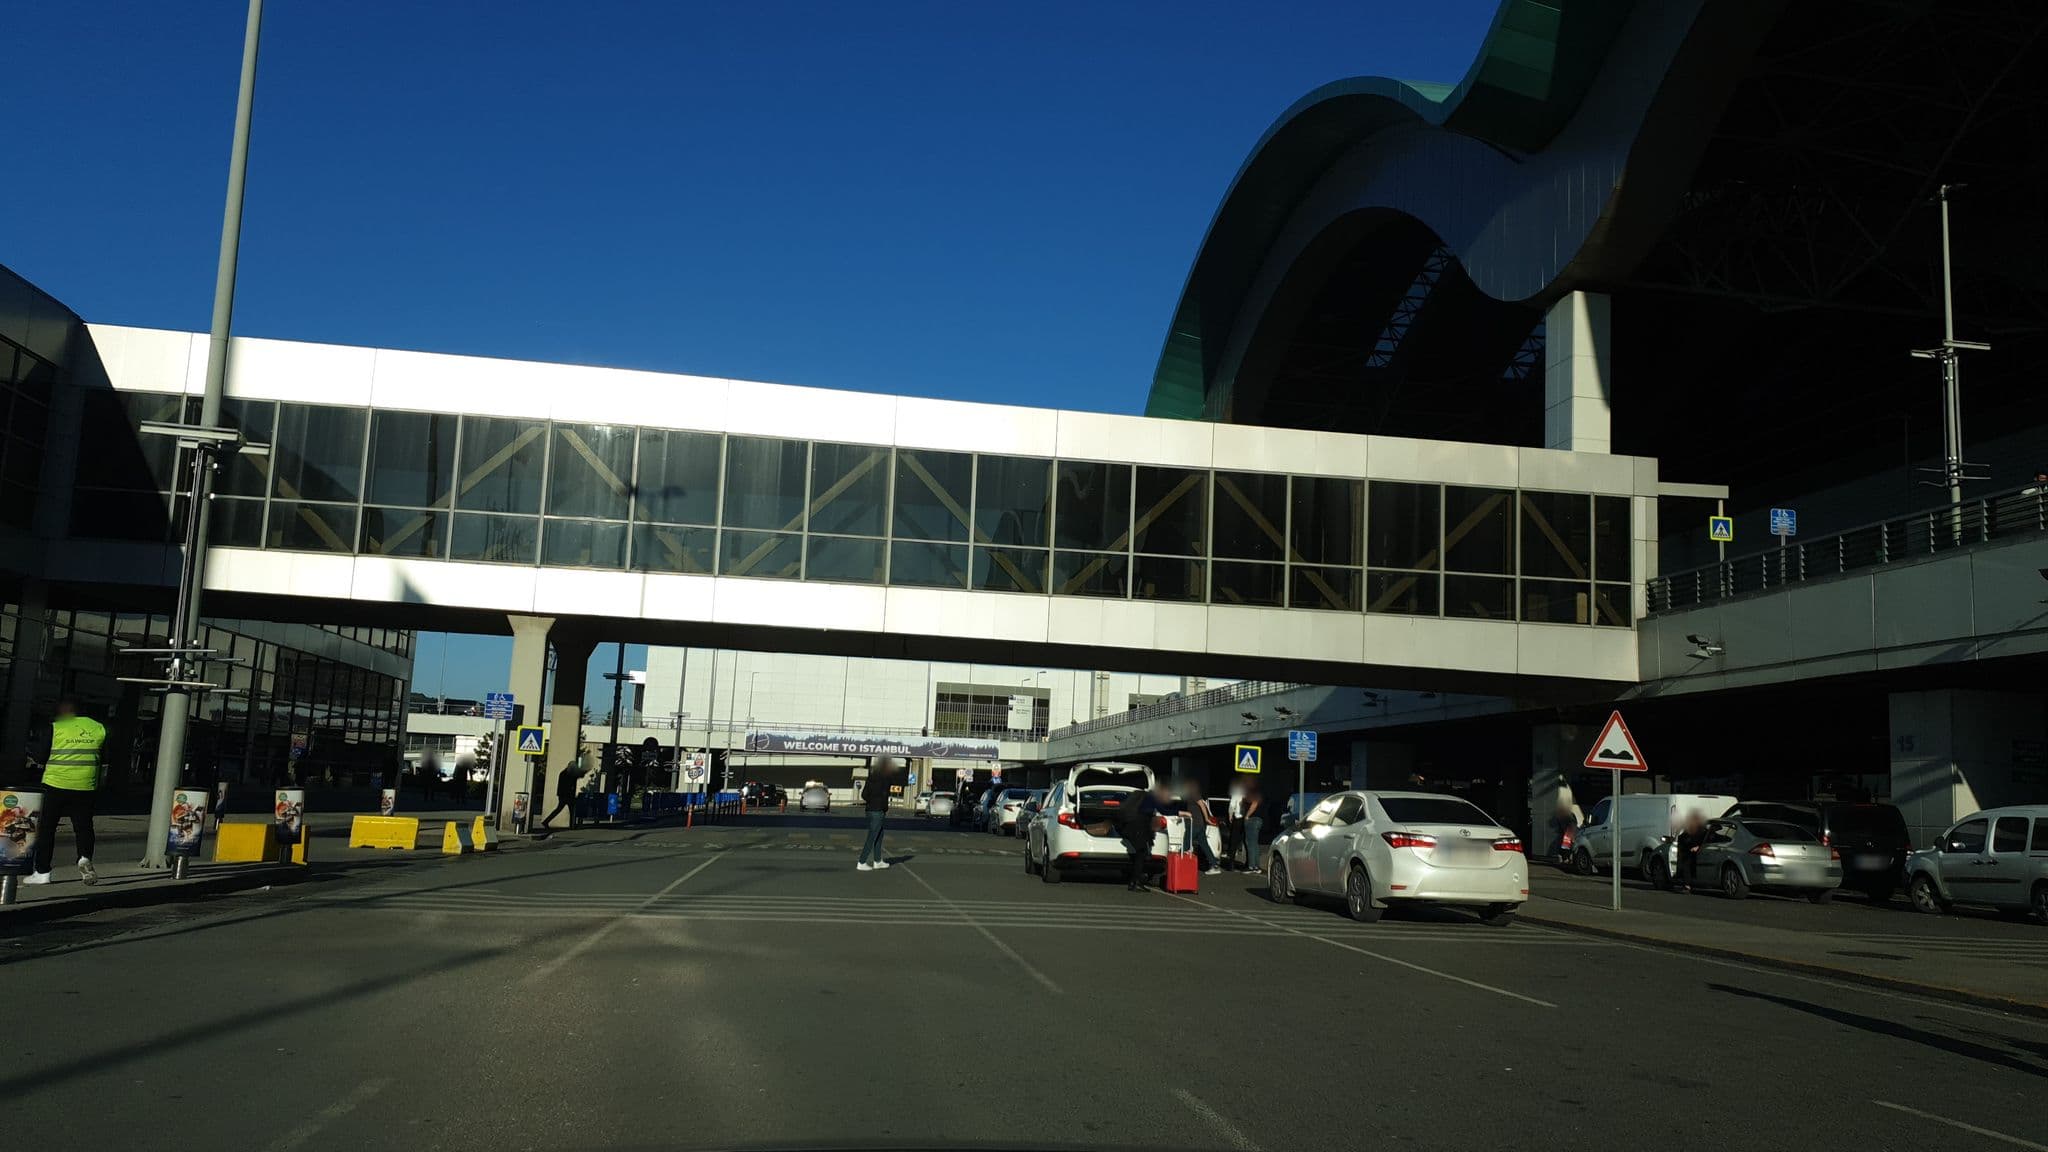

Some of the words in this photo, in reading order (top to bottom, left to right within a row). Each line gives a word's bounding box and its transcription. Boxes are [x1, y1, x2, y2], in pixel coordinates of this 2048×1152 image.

[783, 740, 840, 752] WELCOME
[842, 743, 857, 753] TO
[859, 744, 912, 755] ISTANBUL
